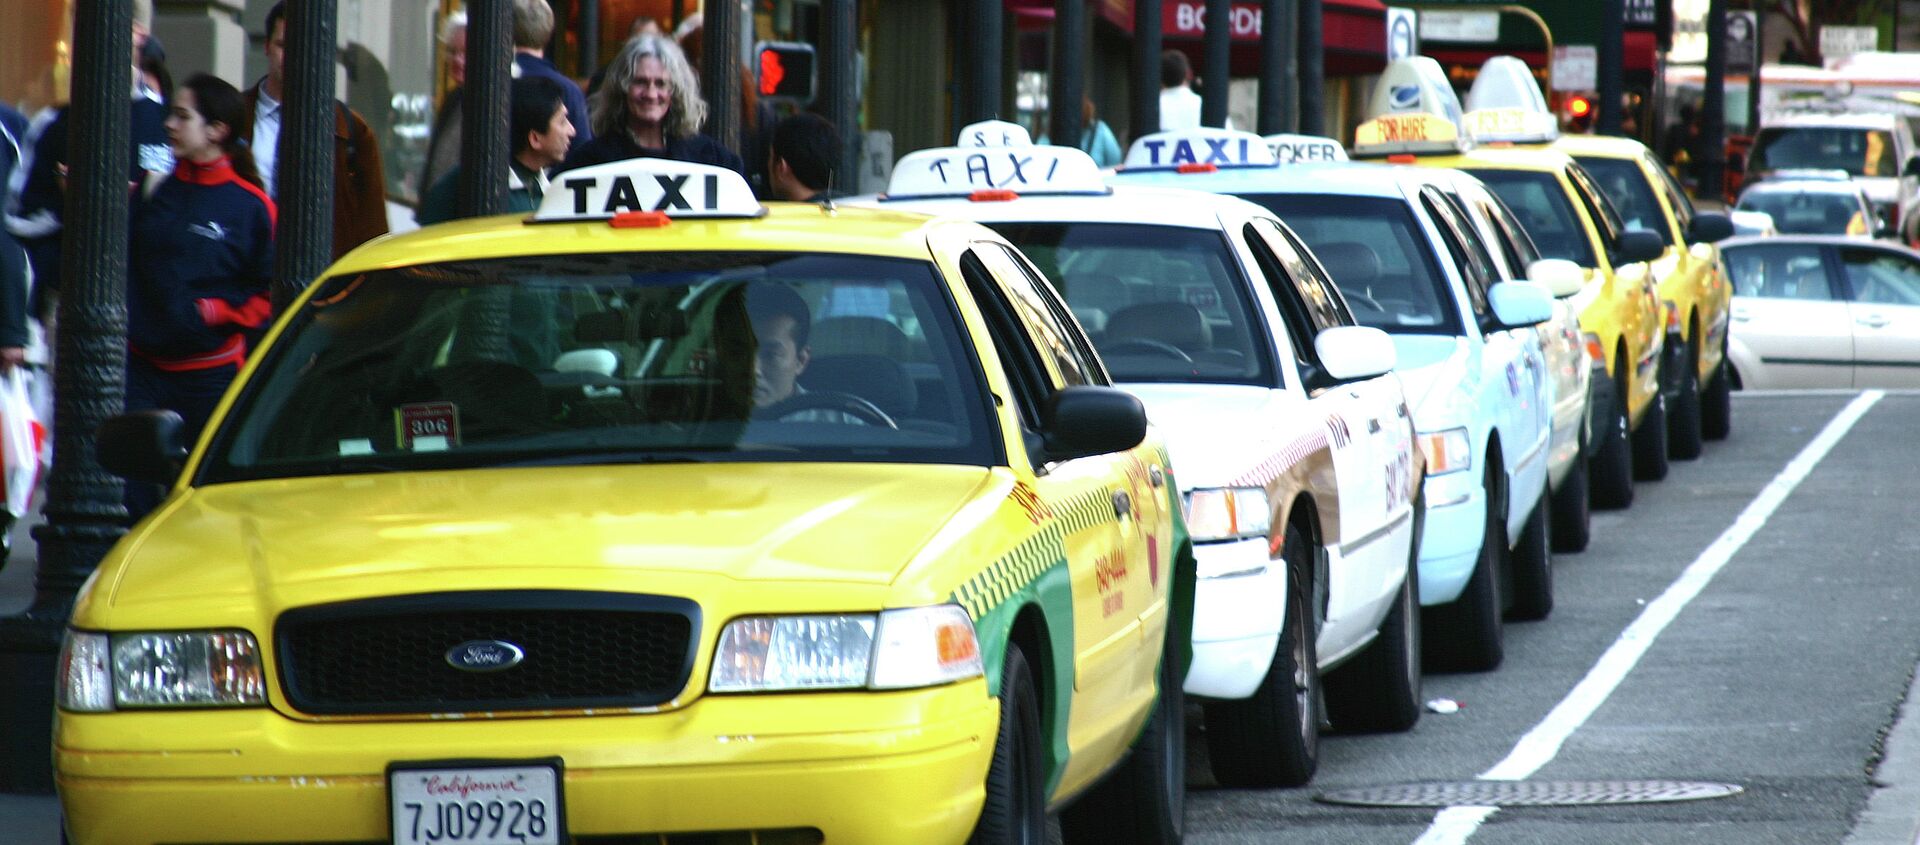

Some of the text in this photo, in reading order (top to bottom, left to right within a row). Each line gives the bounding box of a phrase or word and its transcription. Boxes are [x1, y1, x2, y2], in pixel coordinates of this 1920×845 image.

[1377, 117, 1427, 143] FOR HIRE
[1143, 138, 1248, 165] TAXI
[929, 152, 1057, 188] TAXI
[565, 174, 718, 213] TAXI
[413, 420, 448, 434] 306
[463, 646, 503, 664] Ford
[426, 774, 525, 798] California
[404, 800, 546, 842] 7J09928
